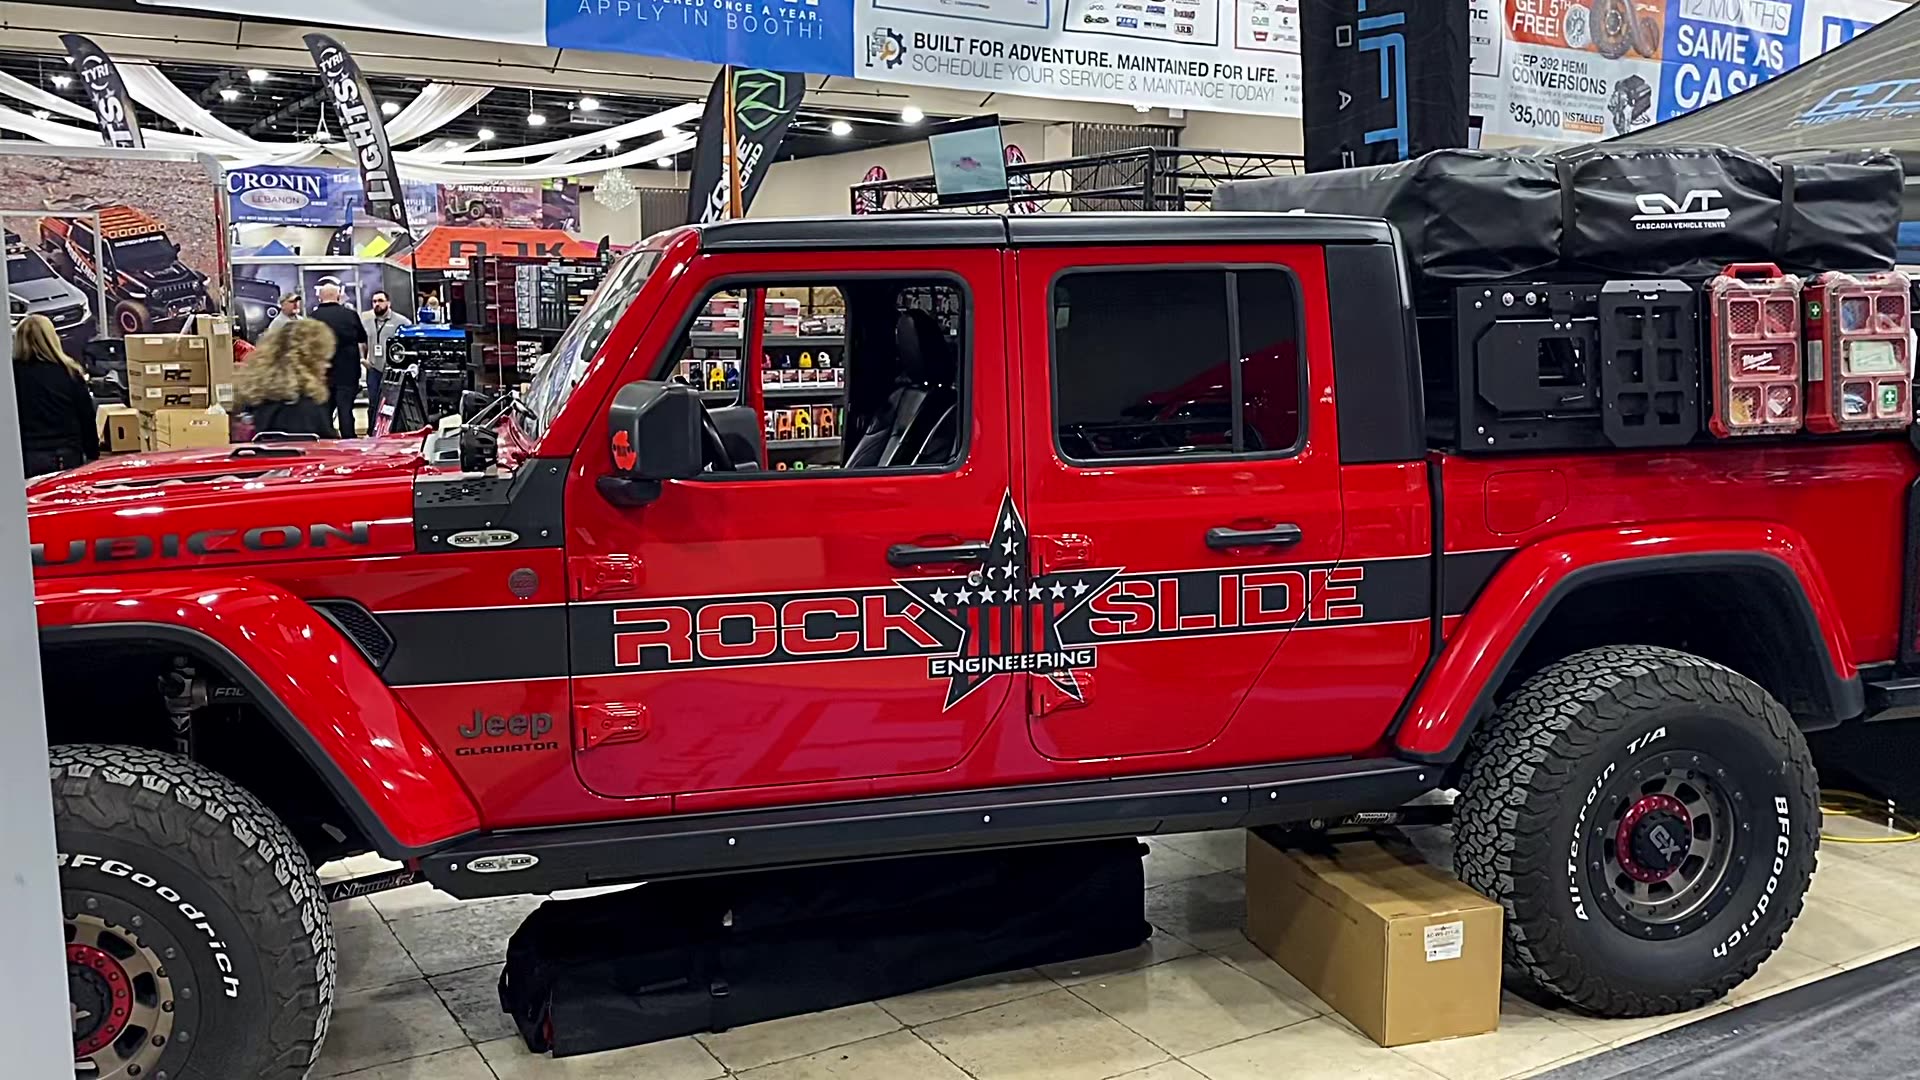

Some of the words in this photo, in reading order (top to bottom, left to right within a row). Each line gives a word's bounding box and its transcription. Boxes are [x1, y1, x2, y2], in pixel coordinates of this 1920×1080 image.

[578, 1, 664, 21] APPLY
[684, 8, 708, 26] IN
[727, 13, 823, 40] BOOTH!
[714, 0, 752, 13] ONCE
[762, 6, 770, 15] A
[779, 8, 823, 22] YEAR.
[1512, 12, 1560, 38] FREE!
[914, 32, 965, 54] BUILT
[969, 39, 1004, 58] FOR
[1008, 43, 1112, 68] ADVENTURE.
[1117, 54, 1209, 77] MAINTAINED
[1213, 63, 1243, 81] FOR
[1247, 66, 1278, 83] LIFE.
[1677, 24, 1750, 64] SAME
[1753, 38, 1784, 70] AS
[81, 63, 110, 83] TYRI
[319, 52, 344, 73] TYRI
[1512, 52, 1538, 67] JEEP
[1540, 57, 1560, 71] 392
[1561, 61, 1588, 75] HEMI
[912, 53, 1004, 80] SCHEDULE
[1008, 64, 1054, 84] YOUR
[1059, 68, 1124, 90] SERVICE
[1128, 75, 1138, 91] &
[1142, 76, 1225, 99] MAINTANCE
[1229, 84, 1275, 102] TODAY!
[1511, 66, 1607, 95] CONVERSIONS
[1674, 62, 1770, 109] CAS
[1509, 102, 1561, 128] $35,000
[333, 78, 394, 201] LIGHTS
[226, 171, 321, 198] CRONIN
[457, 184, 506, 193] AUTHORIZED
[507, 186, 534, 194] DEALER
[251, 193, 300, 204] LEBANON
[1635, 189, 1723, 214] CVT
[1635, 222, 1673, 230] CASCADIA
[1673, 221, 1703, 229] VEHICLE
[613, 595, 943, 667] ROCK
[1089, 566, 1365, 636] SLIDE
[931, 649, 1092, 676] ENGINEERING
[458, 707, 553, 741] Jeep
[455, 742, 559, 757] GLADIATOR
[1626, 726, 1667, 755] T/A
[1712, 796, 1791, 958] BFGoodrich
